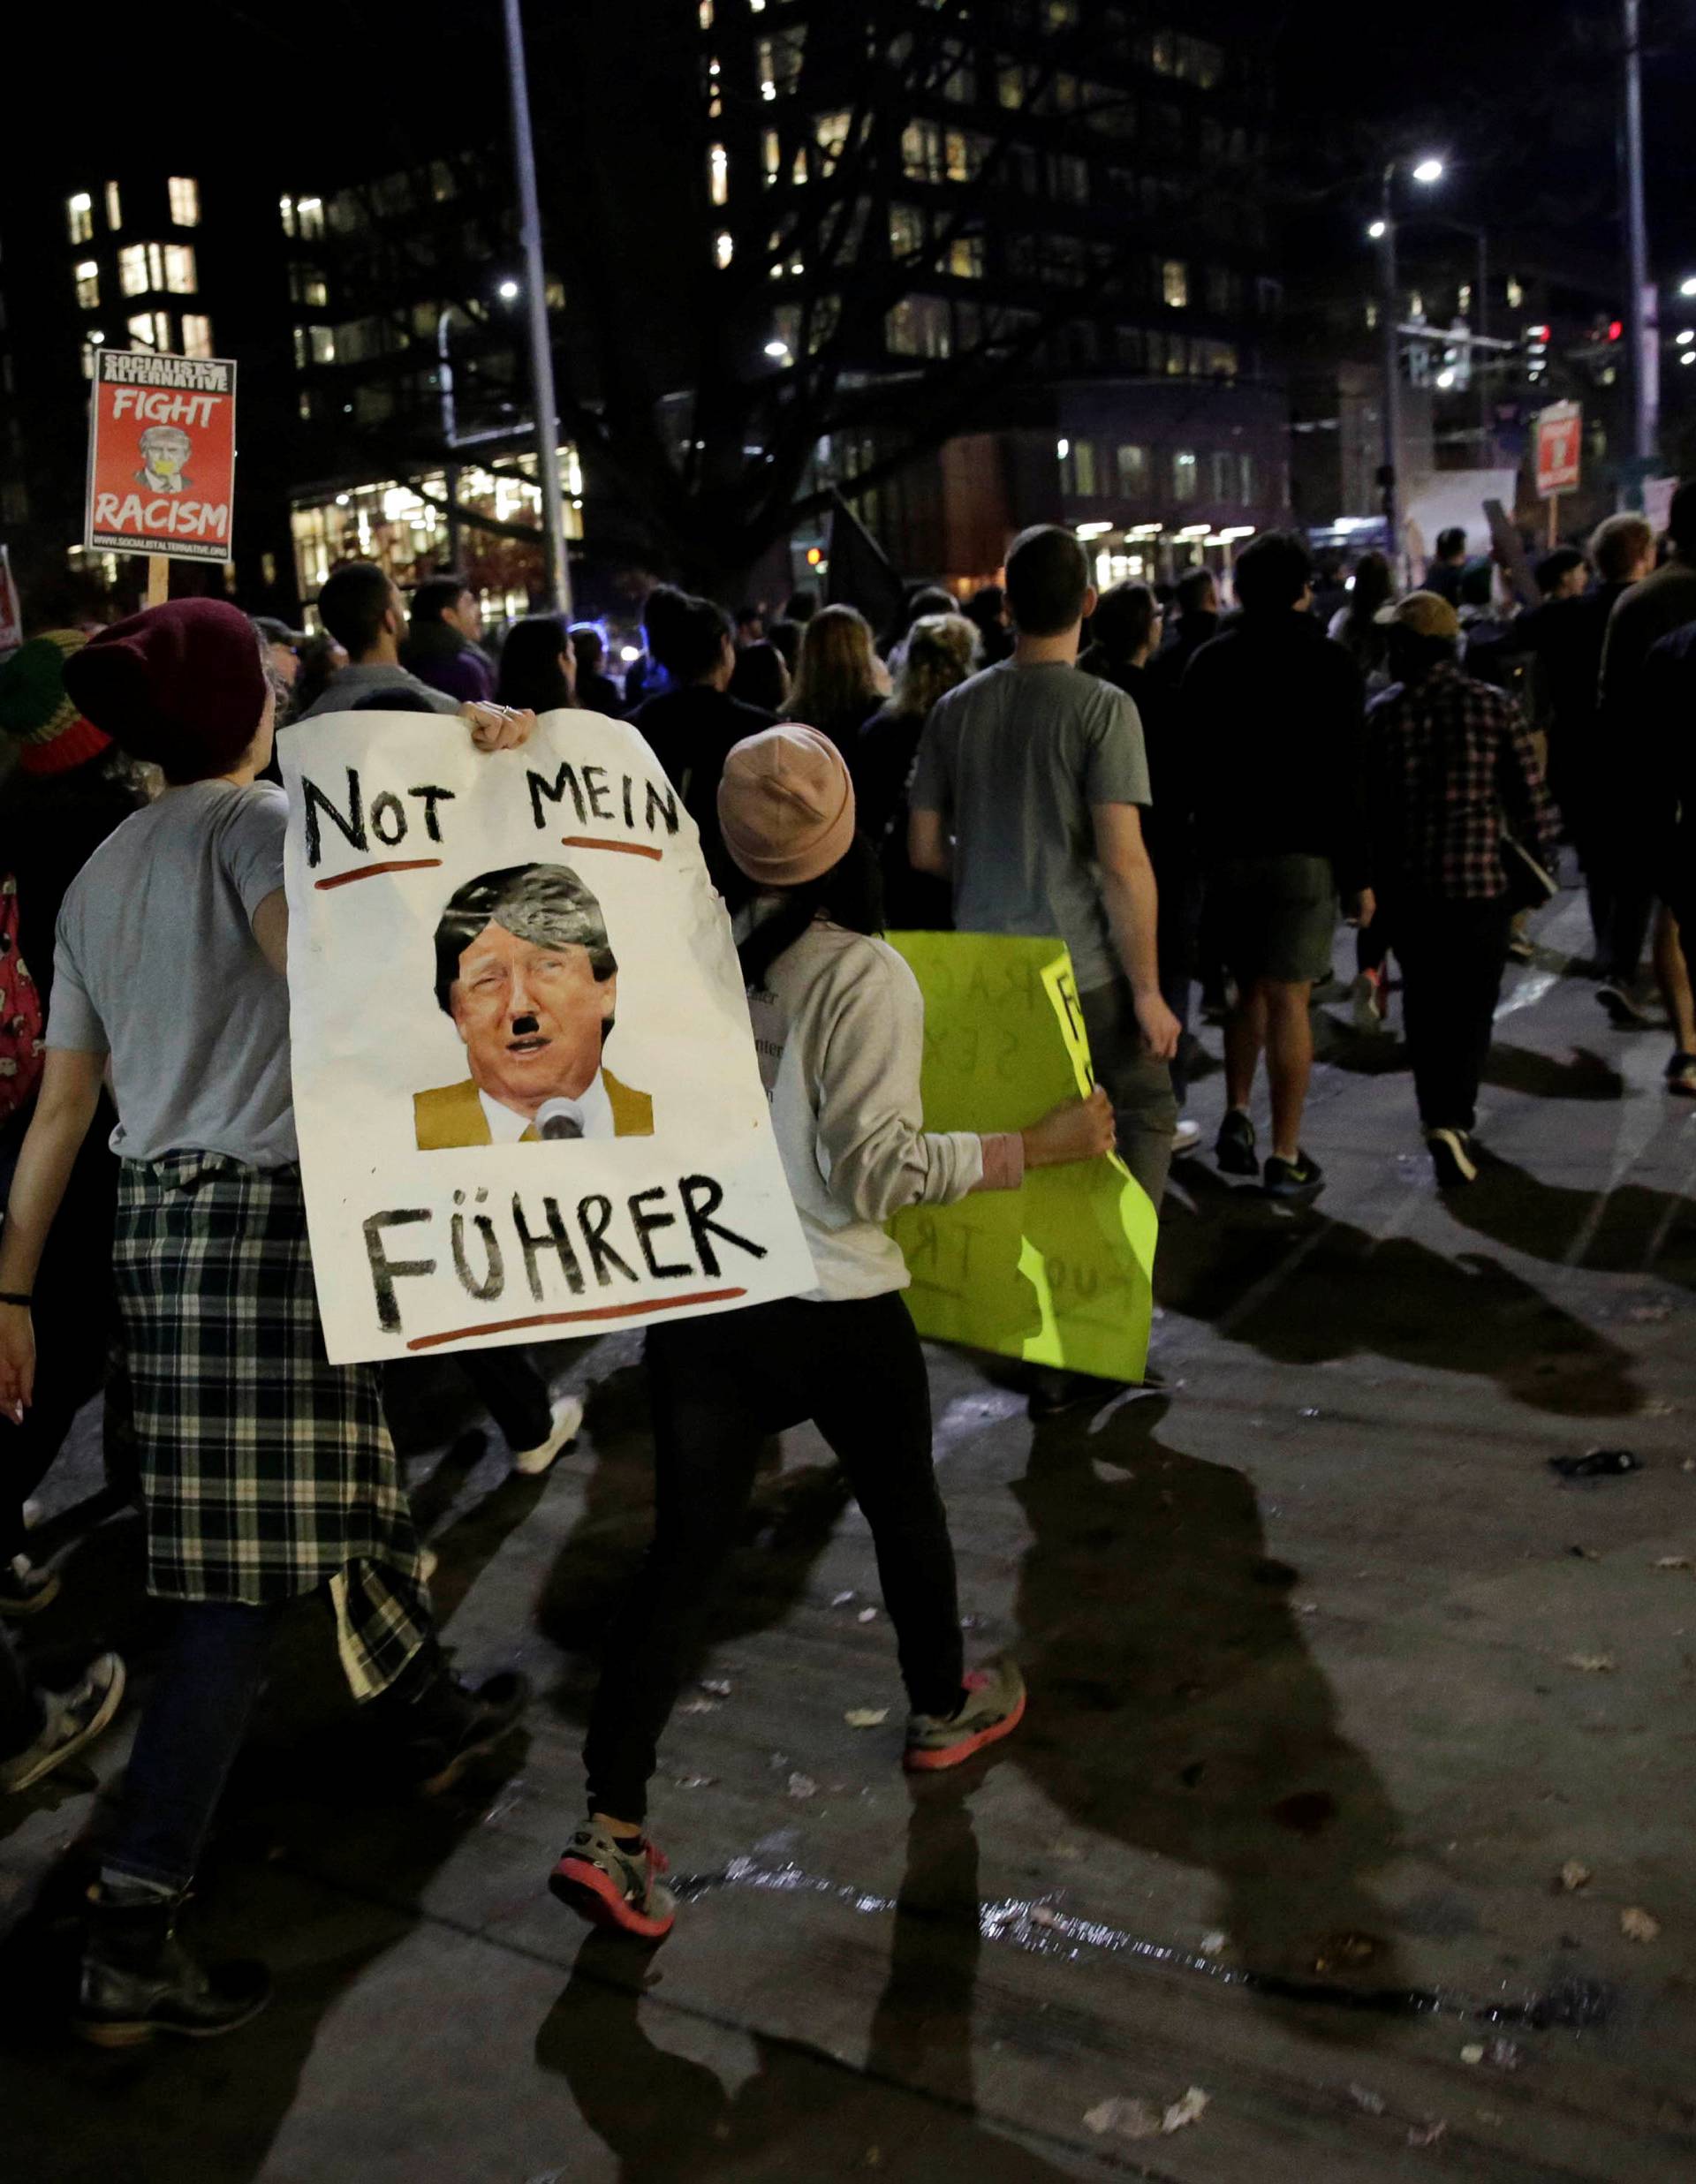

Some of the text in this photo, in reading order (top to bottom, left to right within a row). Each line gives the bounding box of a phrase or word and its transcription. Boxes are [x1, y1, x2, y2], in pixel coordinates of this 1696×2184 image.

[104, 354, 204, 378] SOCIALIST
[104, 367, 228, 391] ALTERNATIVE
[113, 389, 223, 428] FIGHT
[95, 493, 229, 538] RACISM
[300, 763, 685, 868] NOT MEIN
[362, 1175, 768, 1334] FÜHRER
